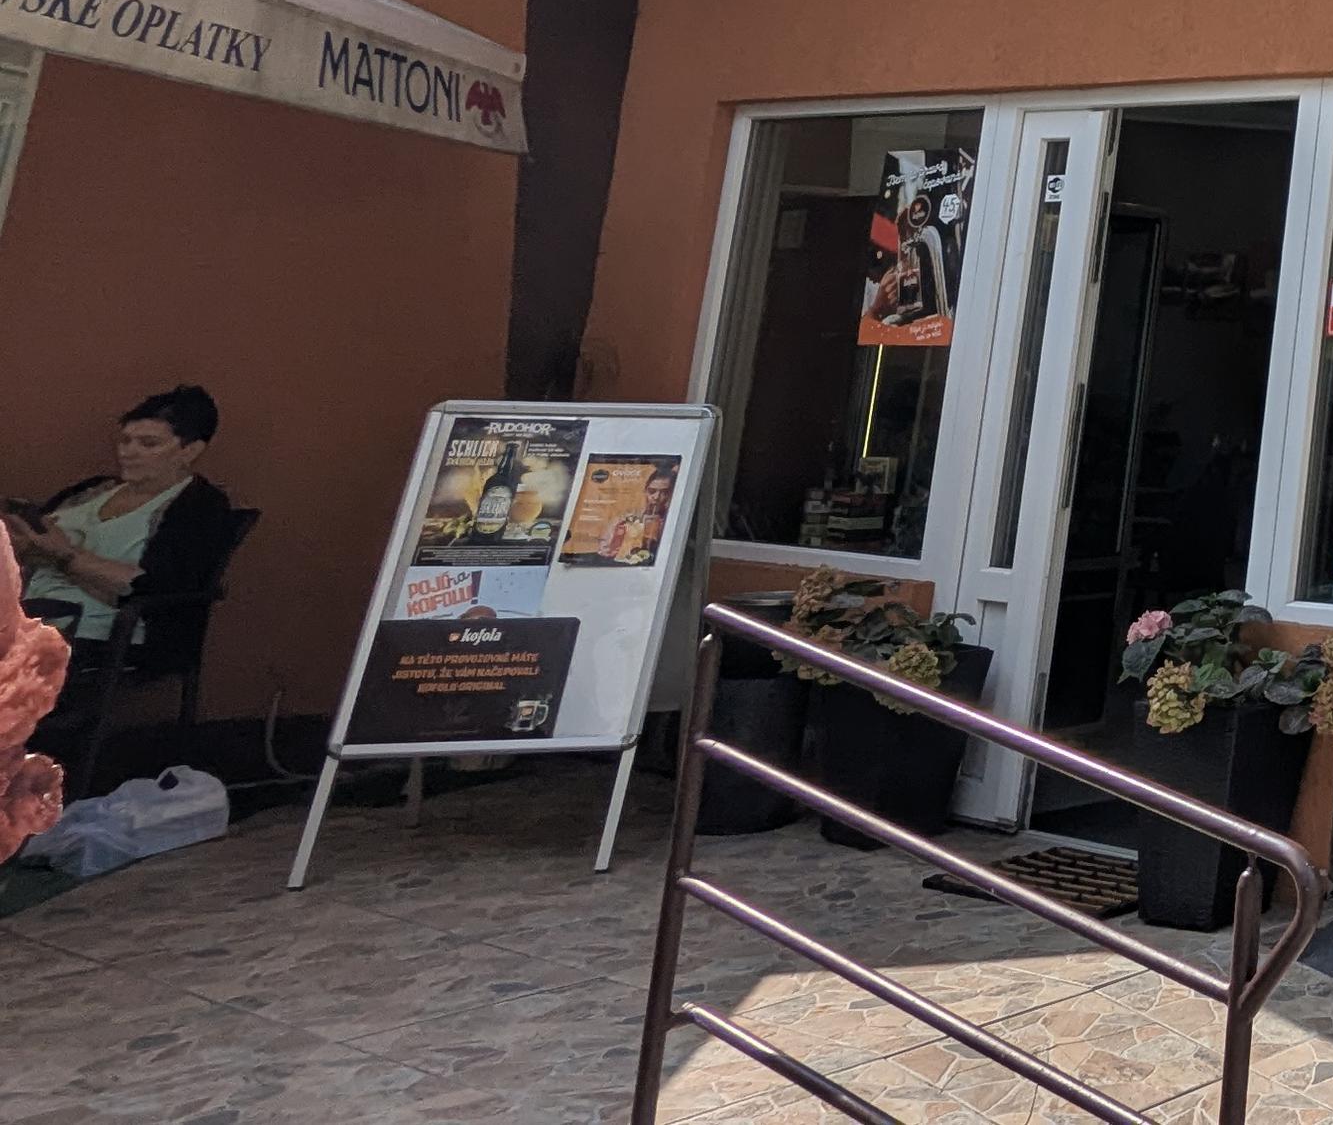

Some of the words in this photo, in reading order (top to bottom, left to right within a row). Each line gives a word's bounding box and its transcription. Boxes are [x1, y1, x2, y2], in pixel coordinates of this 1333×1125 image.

[318, 30, 461, 123] MATTONI
[486, 421, 553, 436] RUDOHOR
[460, 628, 502, 645] kofola
